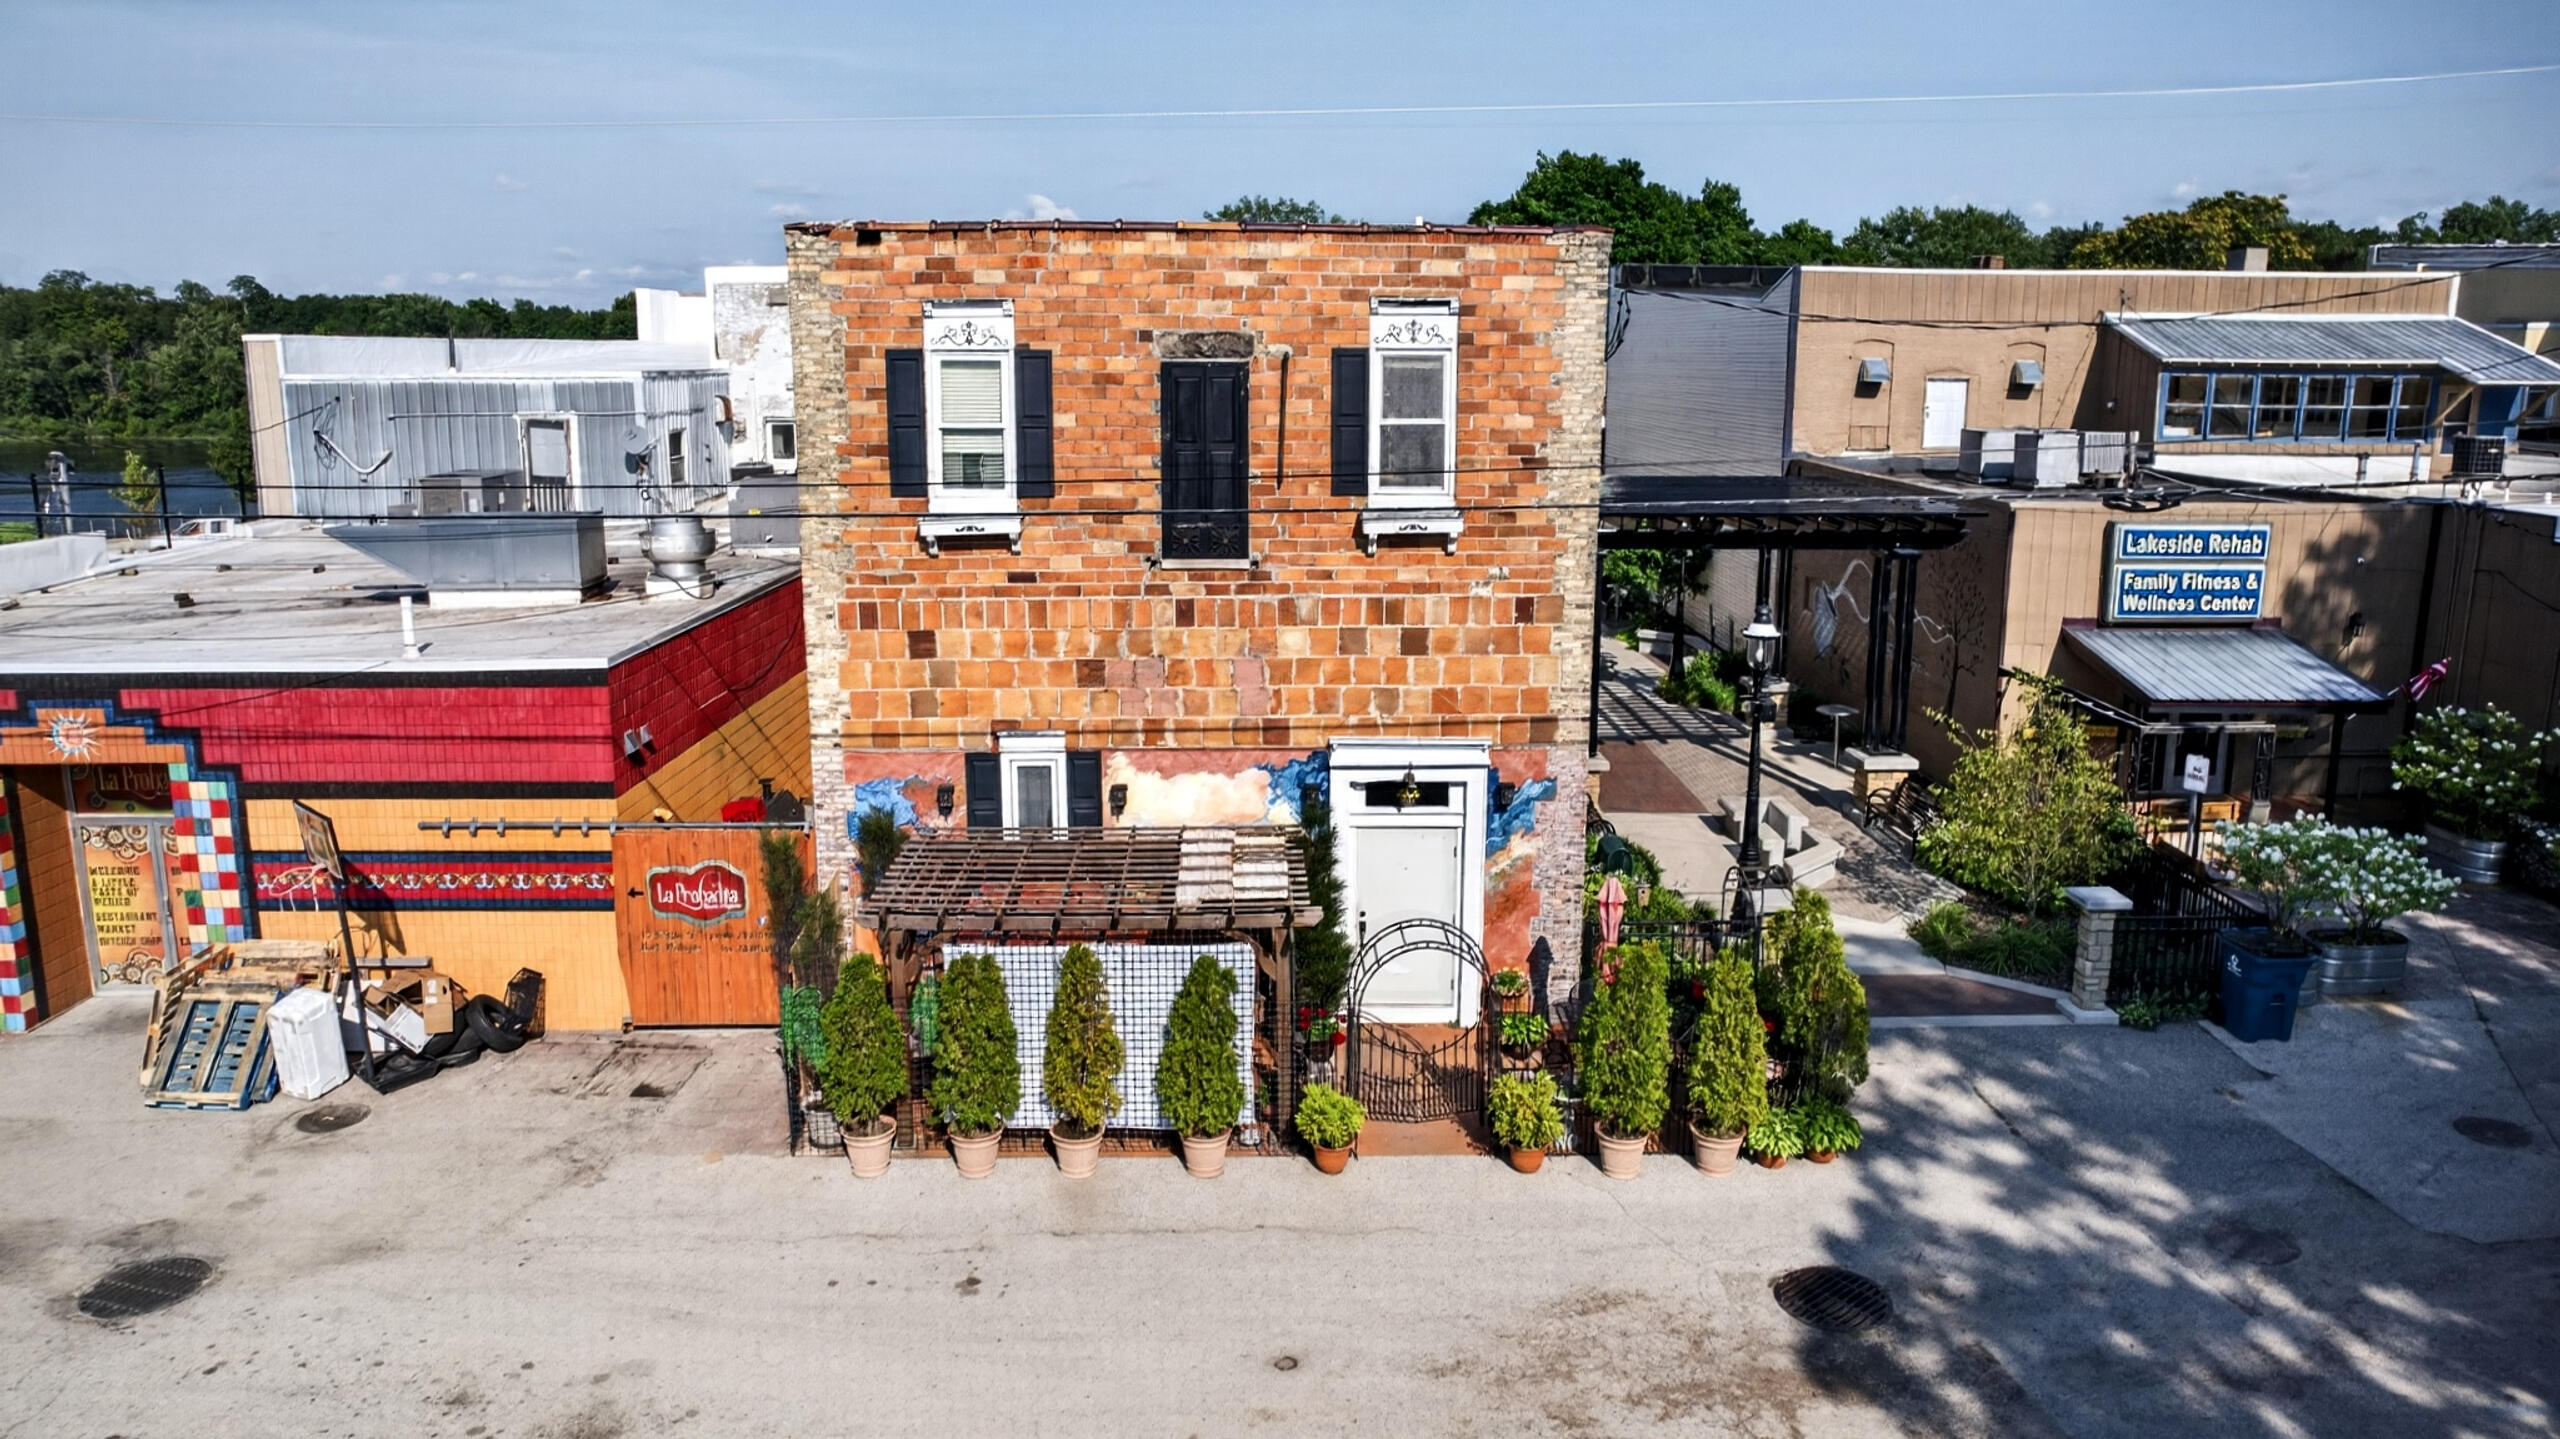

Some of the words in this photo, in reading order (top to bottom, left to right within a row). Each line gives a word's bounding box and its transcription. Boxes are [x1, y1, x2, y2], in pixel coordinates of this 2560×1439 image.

[2126, 533, 2204, 554] Lakeside
[2208, 533, 2263, 554] Rehab
[2123, 573, 2178, 594] Family
[2182, 573, 2241, 590] Fitness
[2246, 573, 2259, 590] &
[2122, 595, 2195, 612] Wellness
[2200, 595, 2256, 612] Center
